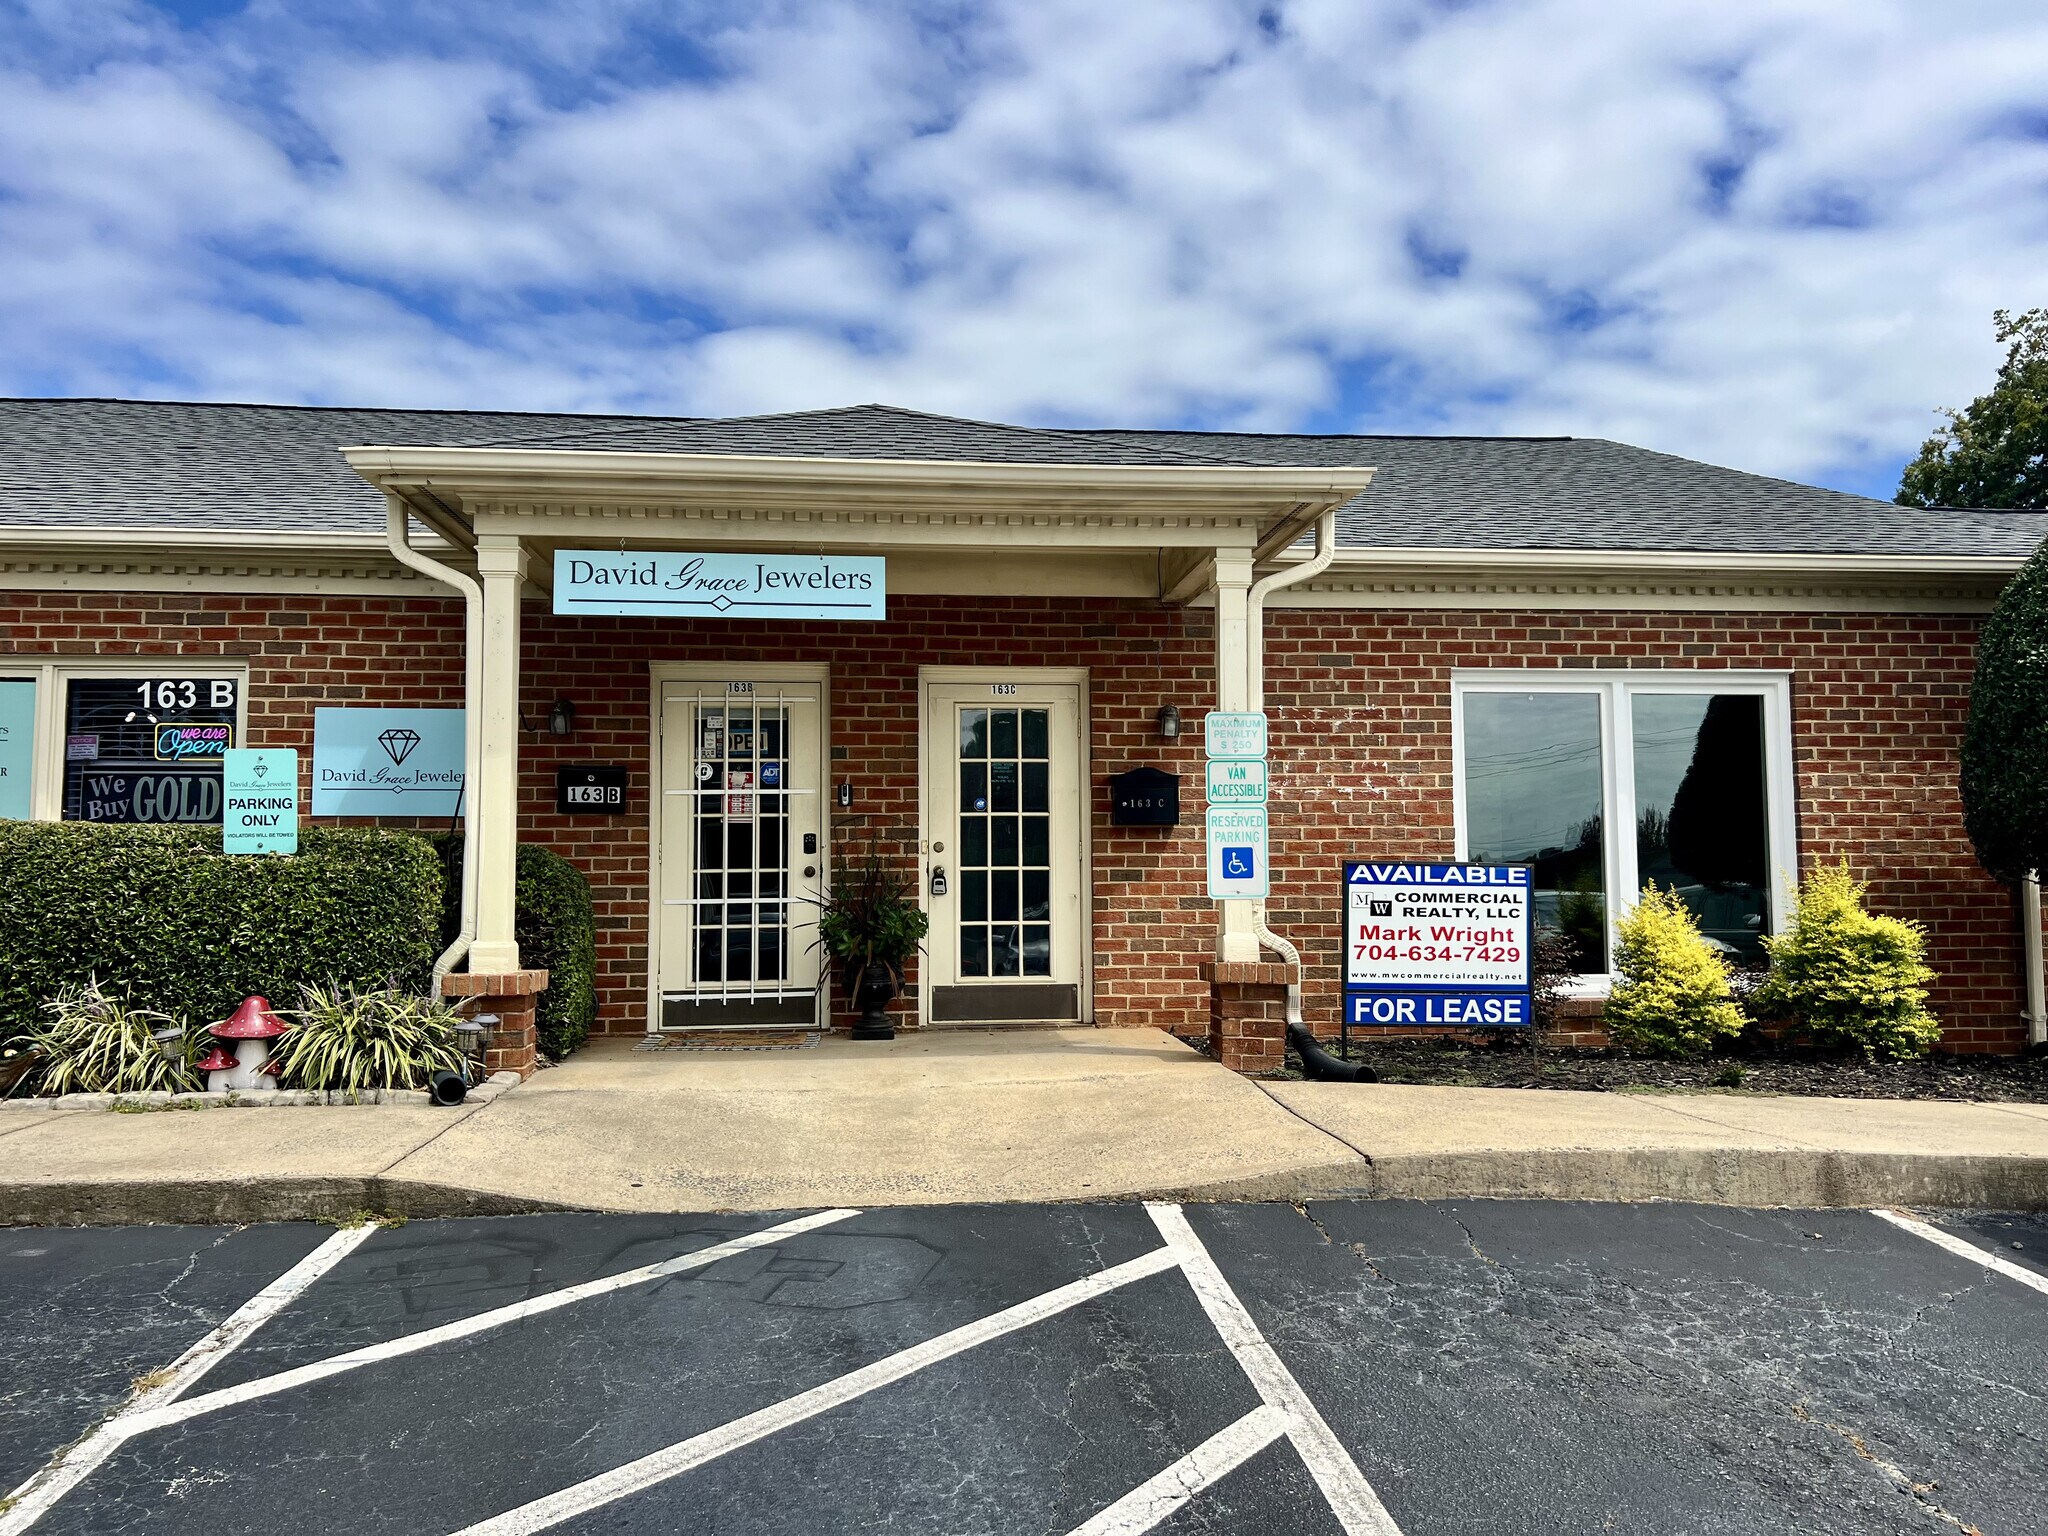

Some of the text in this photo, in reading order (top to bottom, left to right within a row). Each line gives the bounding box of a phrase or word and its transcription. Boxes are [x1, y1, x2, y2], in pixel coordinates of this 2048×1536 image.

[569, 557, 872, 593] David Grace Jewelers
[137, 680, 234, 709] 163 B
[992, 685, 1016, 694] 163C
[1211, 719, 1261, 728] MAXIMUM
[181, 727, 227, 739] we are
[1214, 730, 1258, 738] PENALTY
[158, 728, 229, 760] Open
[1232, 741, 1252, 749] 250
[321, 769, 366, 782] David
[369, 766, 412, 784] Grace
[762, 768, 779, 777] ADT
[1228, 767, 1246, 779] VAN
[89, 775, 126, 797] We
[1211, 784, 1263, 797] ACCESSIBLE
[133, 776, 220, 822] GOLD
[228, 798, 293, 810] PARKING
[1130, 798, 1164, 808] 163 C
[87, 799, 130, 820] Buy
[241, 814, 280, 827] ONLY
[1211, 815, 1263, 827] RESERVED
[1214, 832, 1260, 843] PARKING
[1350, 864, 1527, 884] AVAILABLE
[1356, 894, 1368, 905] M
[1394, 892, 1523, 904] COMMERCIAL
[1373, 901, 1388, 915] W
[1402, 907, 1521, 920] REALTY, LLC
[1359, 925, 1515, 946] Mark Wright
[1353, 945, 1521, 963] 704-634-7429
[1351, 971, 1523, 981] www.mwcommercialrealty.net
[1355, 998, 1522, 1023] FOR LEASE
